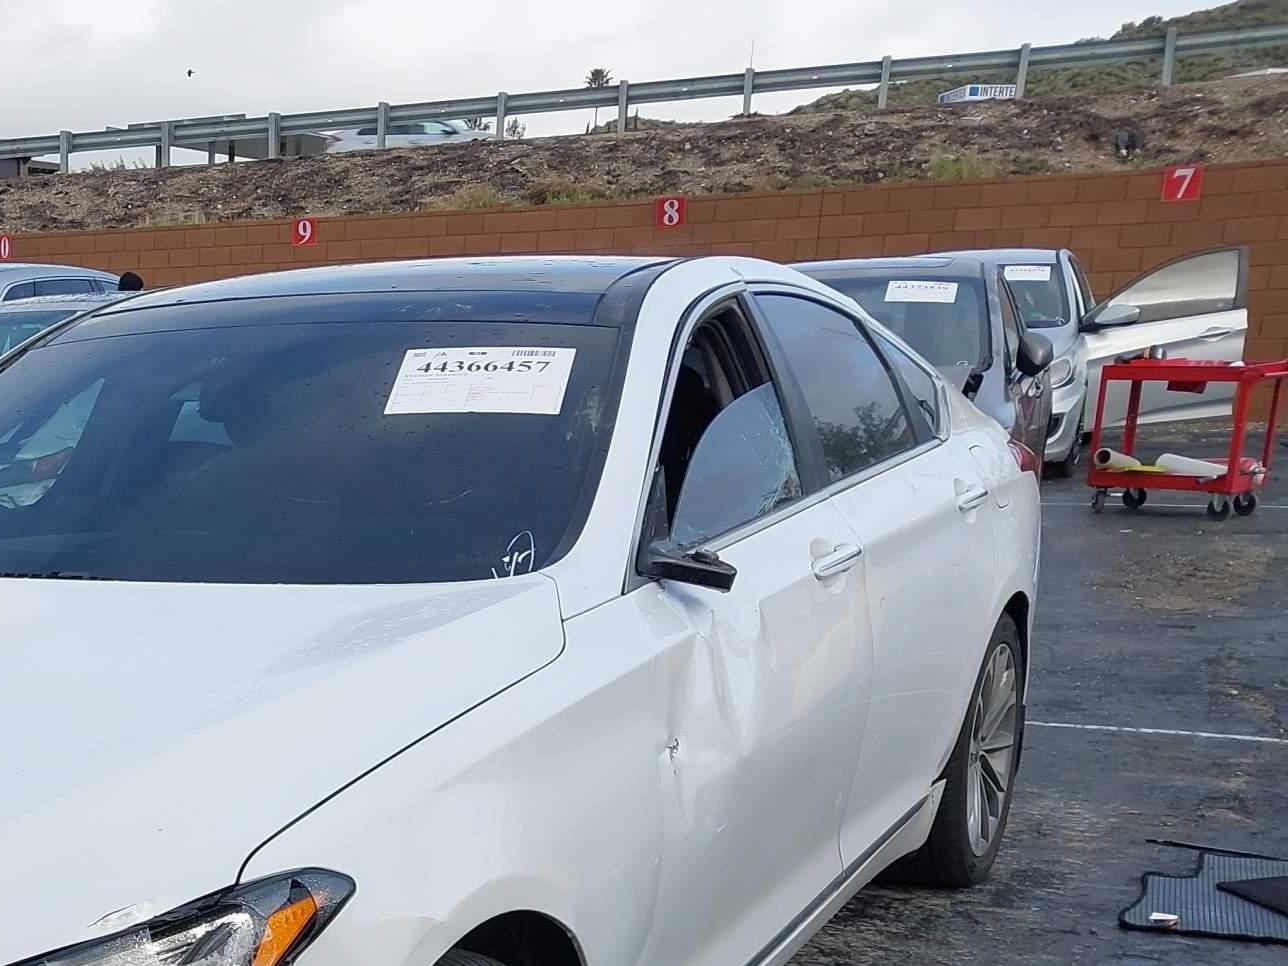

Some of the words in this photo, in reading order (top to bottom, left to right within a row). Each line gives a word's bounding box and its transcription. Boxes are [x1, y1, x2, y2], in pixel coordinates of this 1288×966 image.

[980, 86, 1015, 97] INTERTE
[1173, 168, 1195, 199] 7
[663, 199, 679, 226] 8
[297, 220, 312, 245] 9
[417, 360, 551, 373] 44366457
